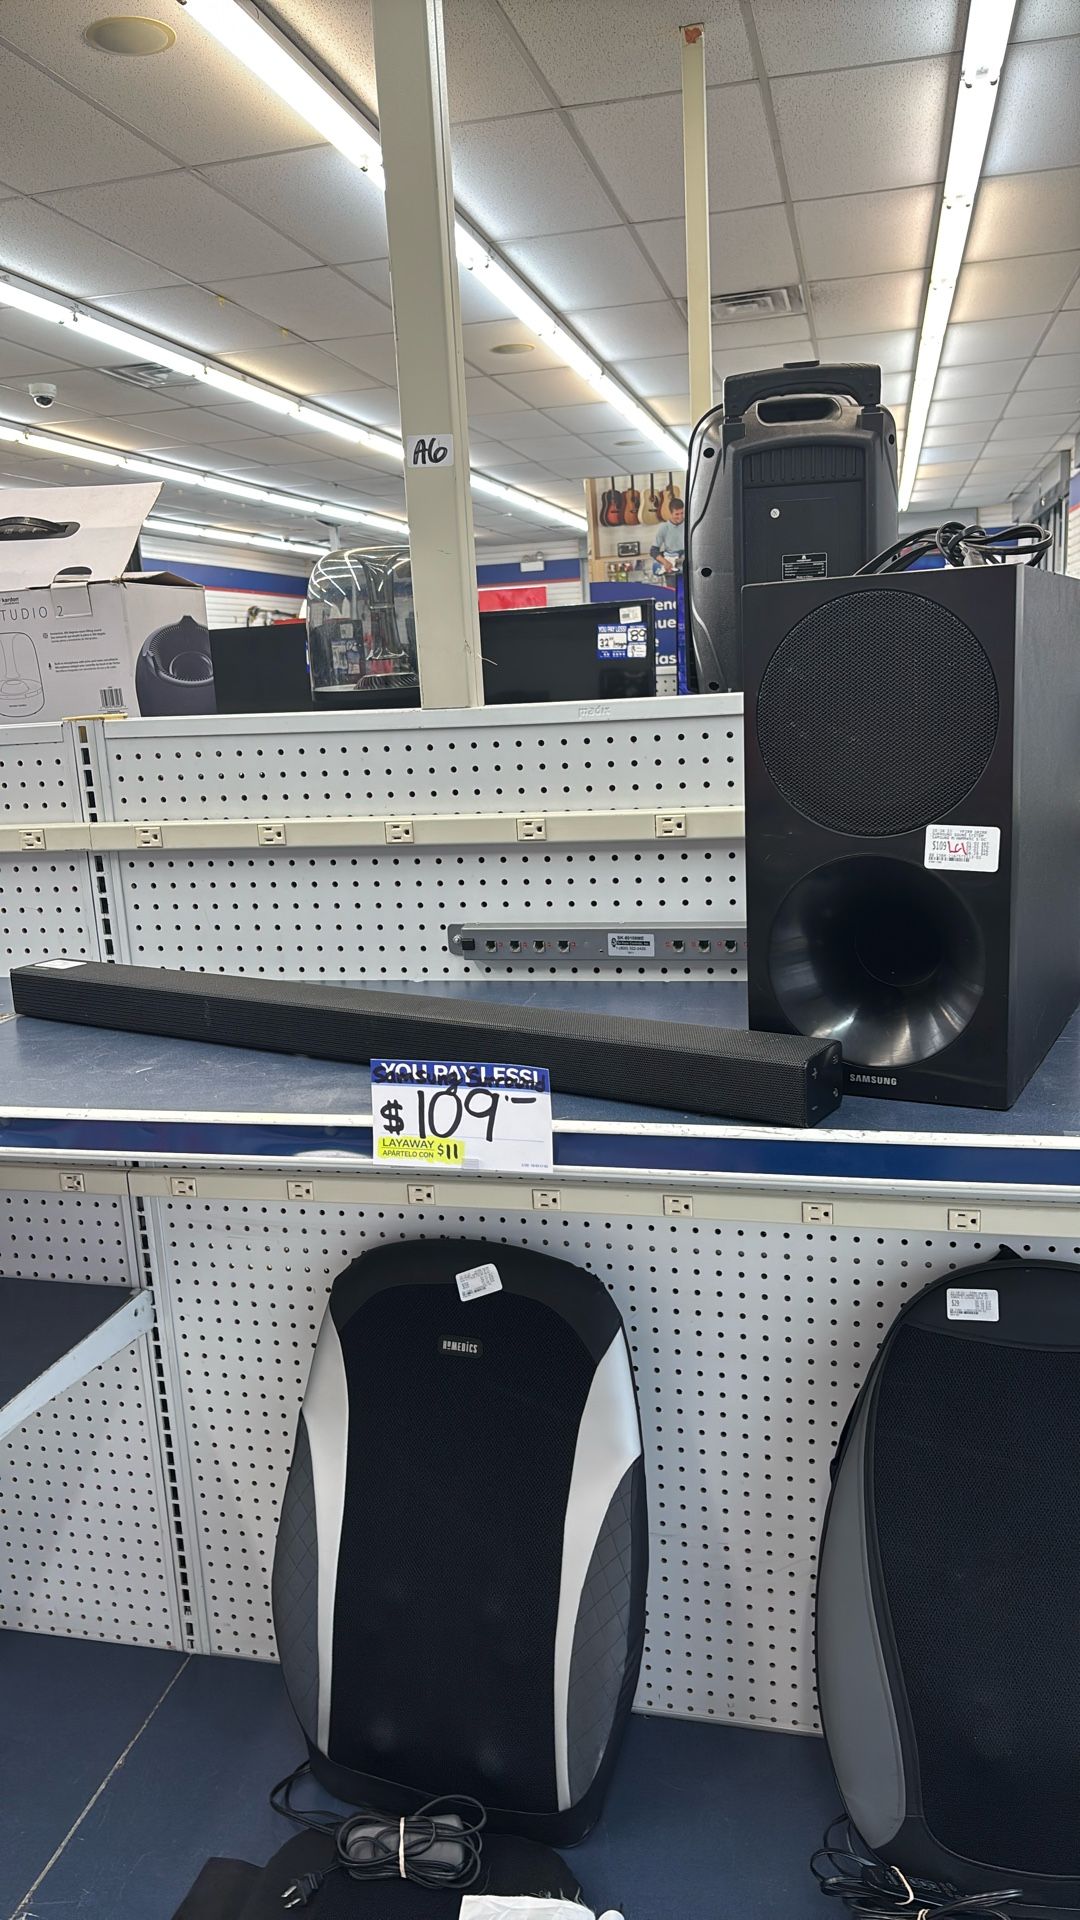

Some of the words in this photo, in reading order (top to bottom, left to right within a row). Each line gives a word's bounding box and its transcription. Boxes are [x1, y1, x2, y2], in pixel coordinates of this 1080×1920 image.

[412, 437, 448, 465] A6
[0, 606, 48, 621] TUDIO
[57, 605, 64, 617] 2
[655, 653, 677, 665] ías
[380, 1063, 427, 1080] YOU
[849, 1073, 897, 1086] SAMSUNG
[382, 1138, 434, 1149] LAYAWAY
